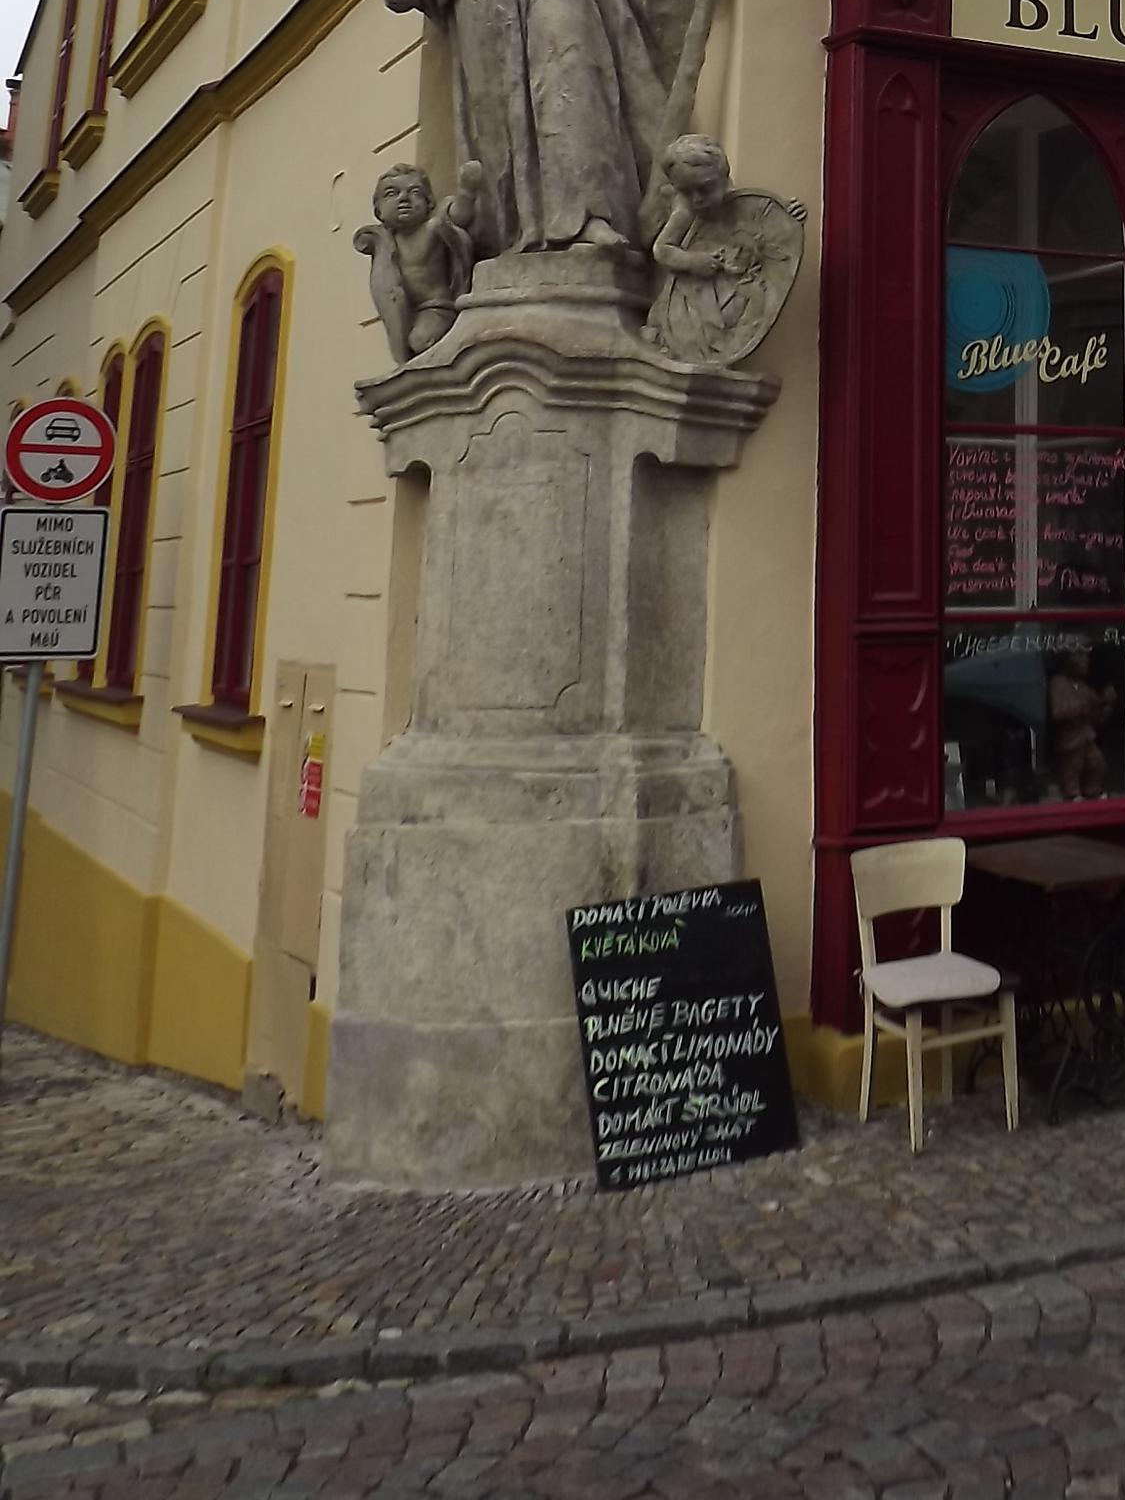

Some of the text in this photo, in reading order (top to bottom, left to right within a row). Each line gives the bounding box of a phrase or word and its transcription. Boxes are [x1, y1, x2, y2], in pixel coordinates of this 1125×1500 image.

[956, 332, 1109, 385] Blues Café
[36, 517, 74, 533] MIMO
[11, 536, 95, 556] SLUŽEBNÍCH
[24, 562, 78, 578] VOZIDEL
[34, 583, 62, 601] PČR
[5, 604, 88, 624] A POVOLENÍ
[581, 976, 663, 1006] QUICHE
[671, 990, 765, 1029] BAGETY
[592, 1061, 726, 1102] CITRONÁDA
